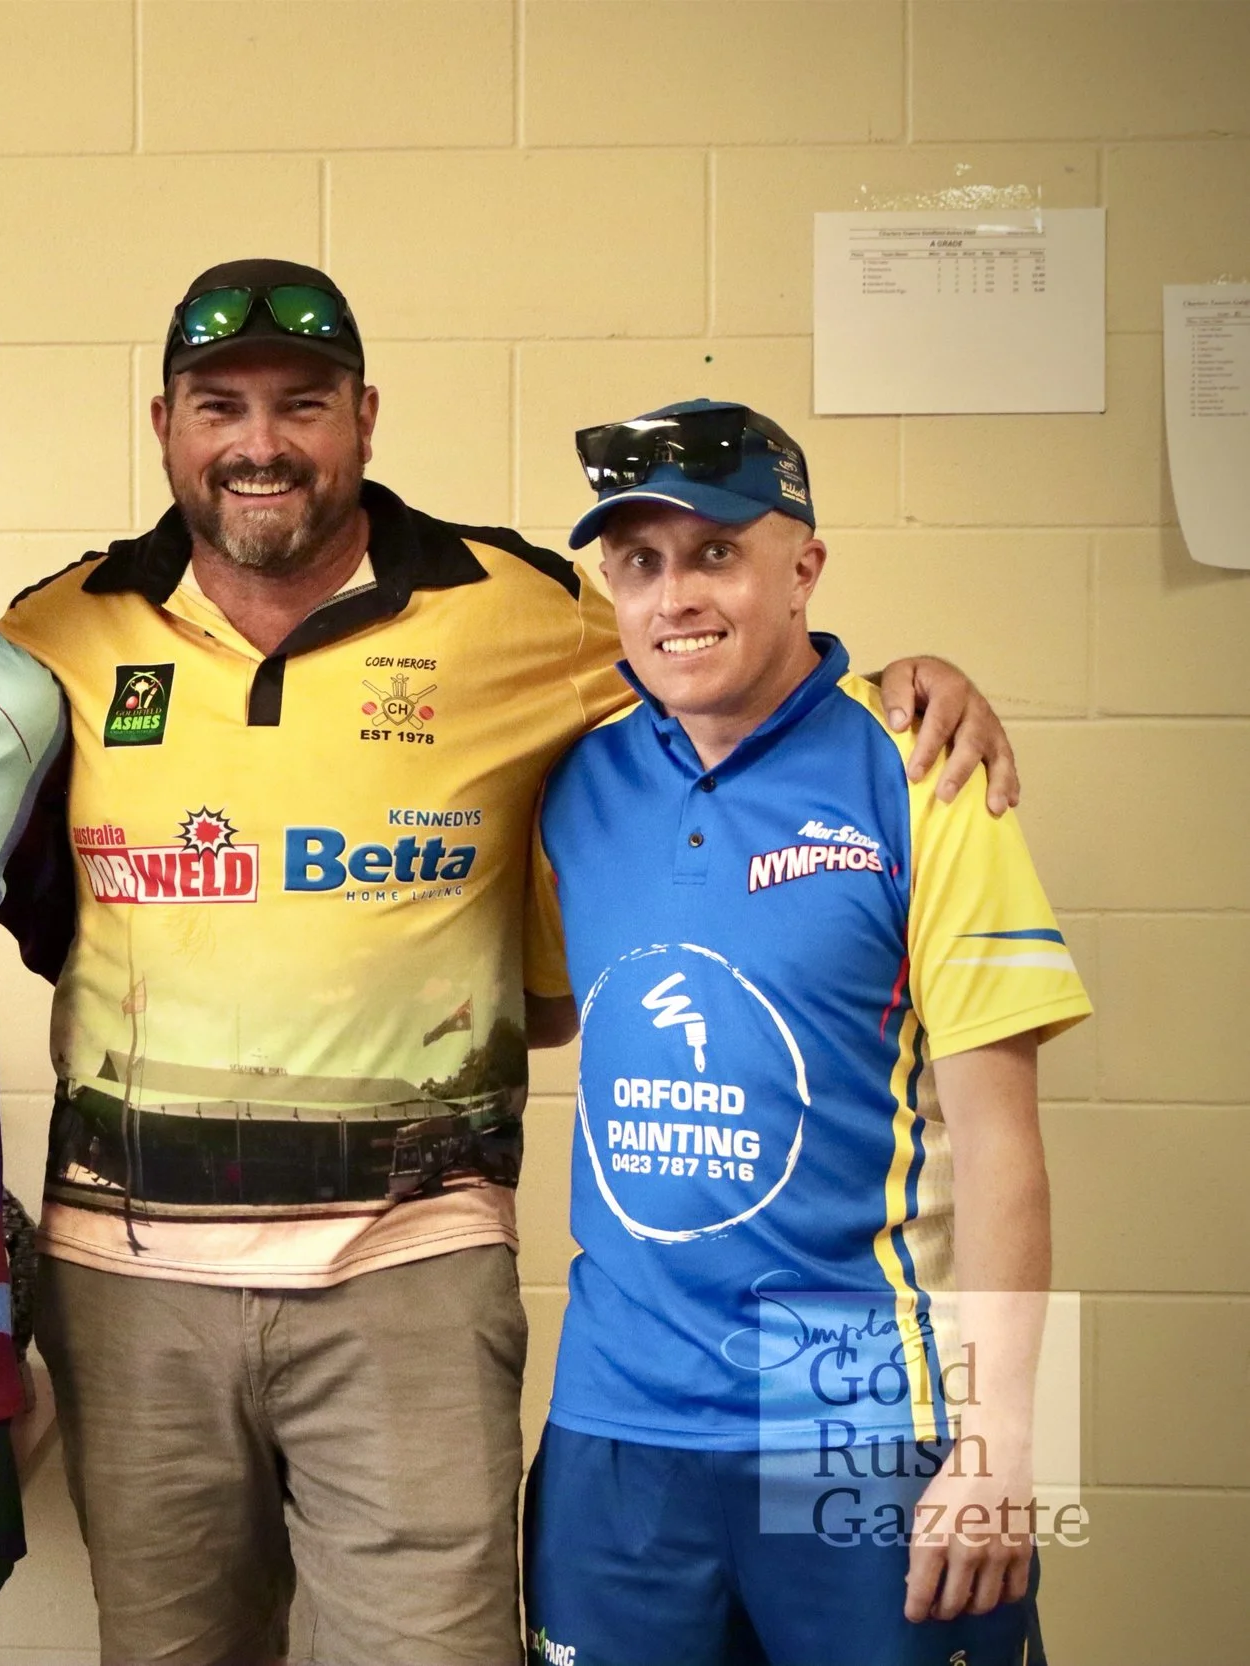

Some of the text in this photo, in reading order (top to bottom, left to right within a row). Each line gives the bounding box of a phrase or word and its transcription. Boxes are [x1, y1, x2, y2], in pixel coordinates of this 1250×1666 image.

[365, 656, 437, 671] COEN HEROES
[387, 702, 408, 716] CH
[110, 714, 161, 731] ASHES
[360, 729, 435, 745] EST 1978
[388, 808, 482, 828] KENNEDYS
[73, 824, 127, 846] australia
[283, 826, 477, 892] Betta
[747, 843, 884, 894] NYMPHOS
[346, 885, 463, 902] HOME LIVING
[613, 1077, 745, 1116] ORFORD
[607, 1119, 761, 1160] PAINTING
[611, 1153, 755, 1183] 0423 787 516
